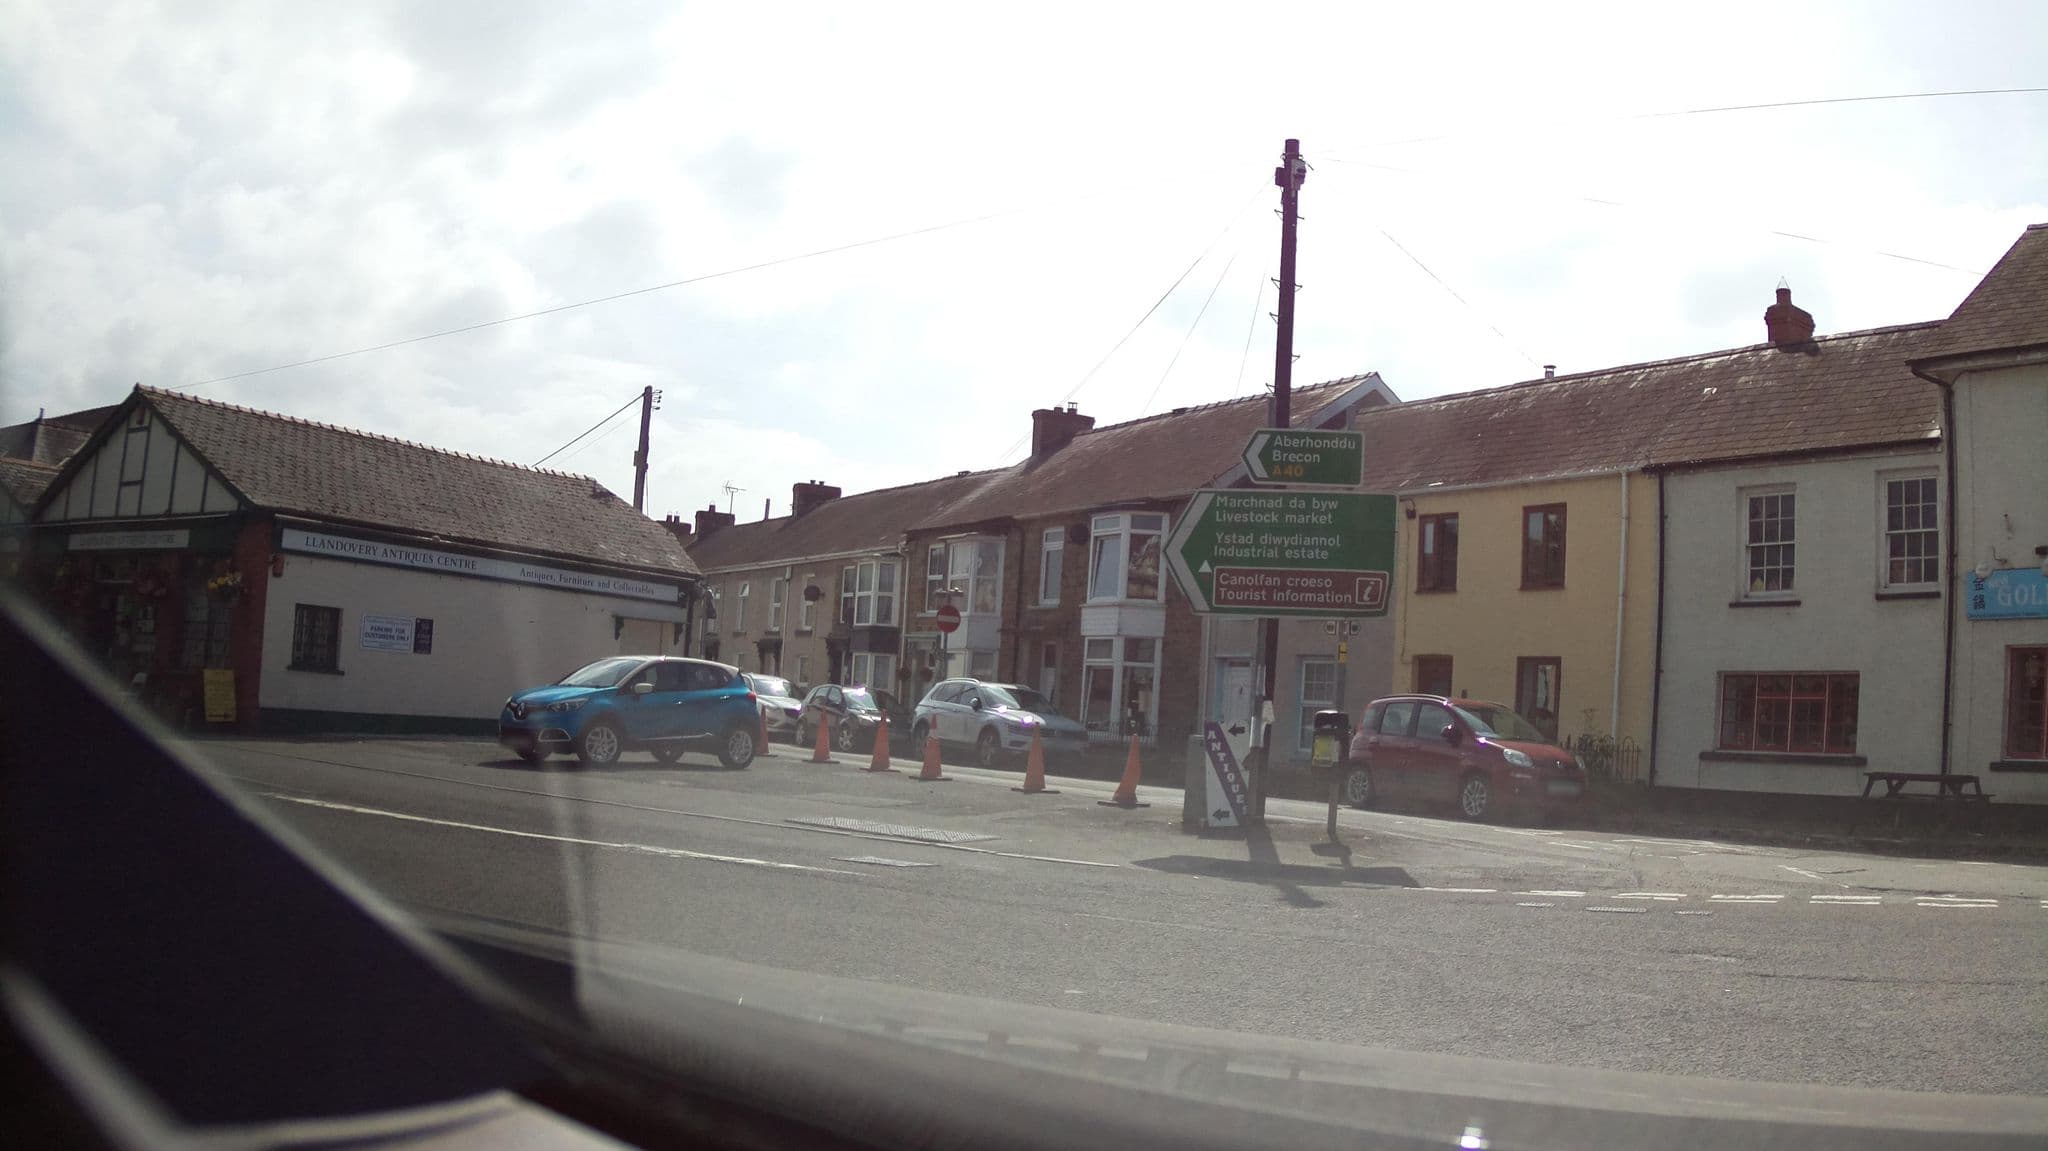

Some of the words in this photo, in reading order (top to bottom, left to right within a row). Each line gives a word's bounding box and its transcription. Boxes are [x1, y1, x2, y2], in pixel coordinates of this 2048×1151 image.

[1274, 435, 1356, 449] Aberhonddu
[1272, 450, 1321, 463] Brecon
[1272, 465, 1304, 477] A40
[1216, 496, 1283, 509] Marchnad
[1289, 496, 1306, 509] da
[1312, 497, 1339, 512] byw
[1216, 511, 1279, 523] Livestock
[1285, 512, 1333, 525] market
[1215, 532, 1254, 545] Ystad
[1259, 533, 1341, 549] diwydiannol
[305, 536, 379, 557] LLANDOVERY
[381, 547, 434, 565] ANTIQUES
[437, 556, 478, 570] CENTRE
[1214, 545, 1279, 559] Industrial
[1285, 547, 1329, 561] estate
[559, 574, 594, 587] Furniture
[1219, 573, 1281, 588] Canolfan
[1286, 576, 1333, 588] croeso
[1219, 588, 1267, 601] Tourist
[1273, 589, 1352, 604] information
[1998, 583, 2048, 607] GOL
